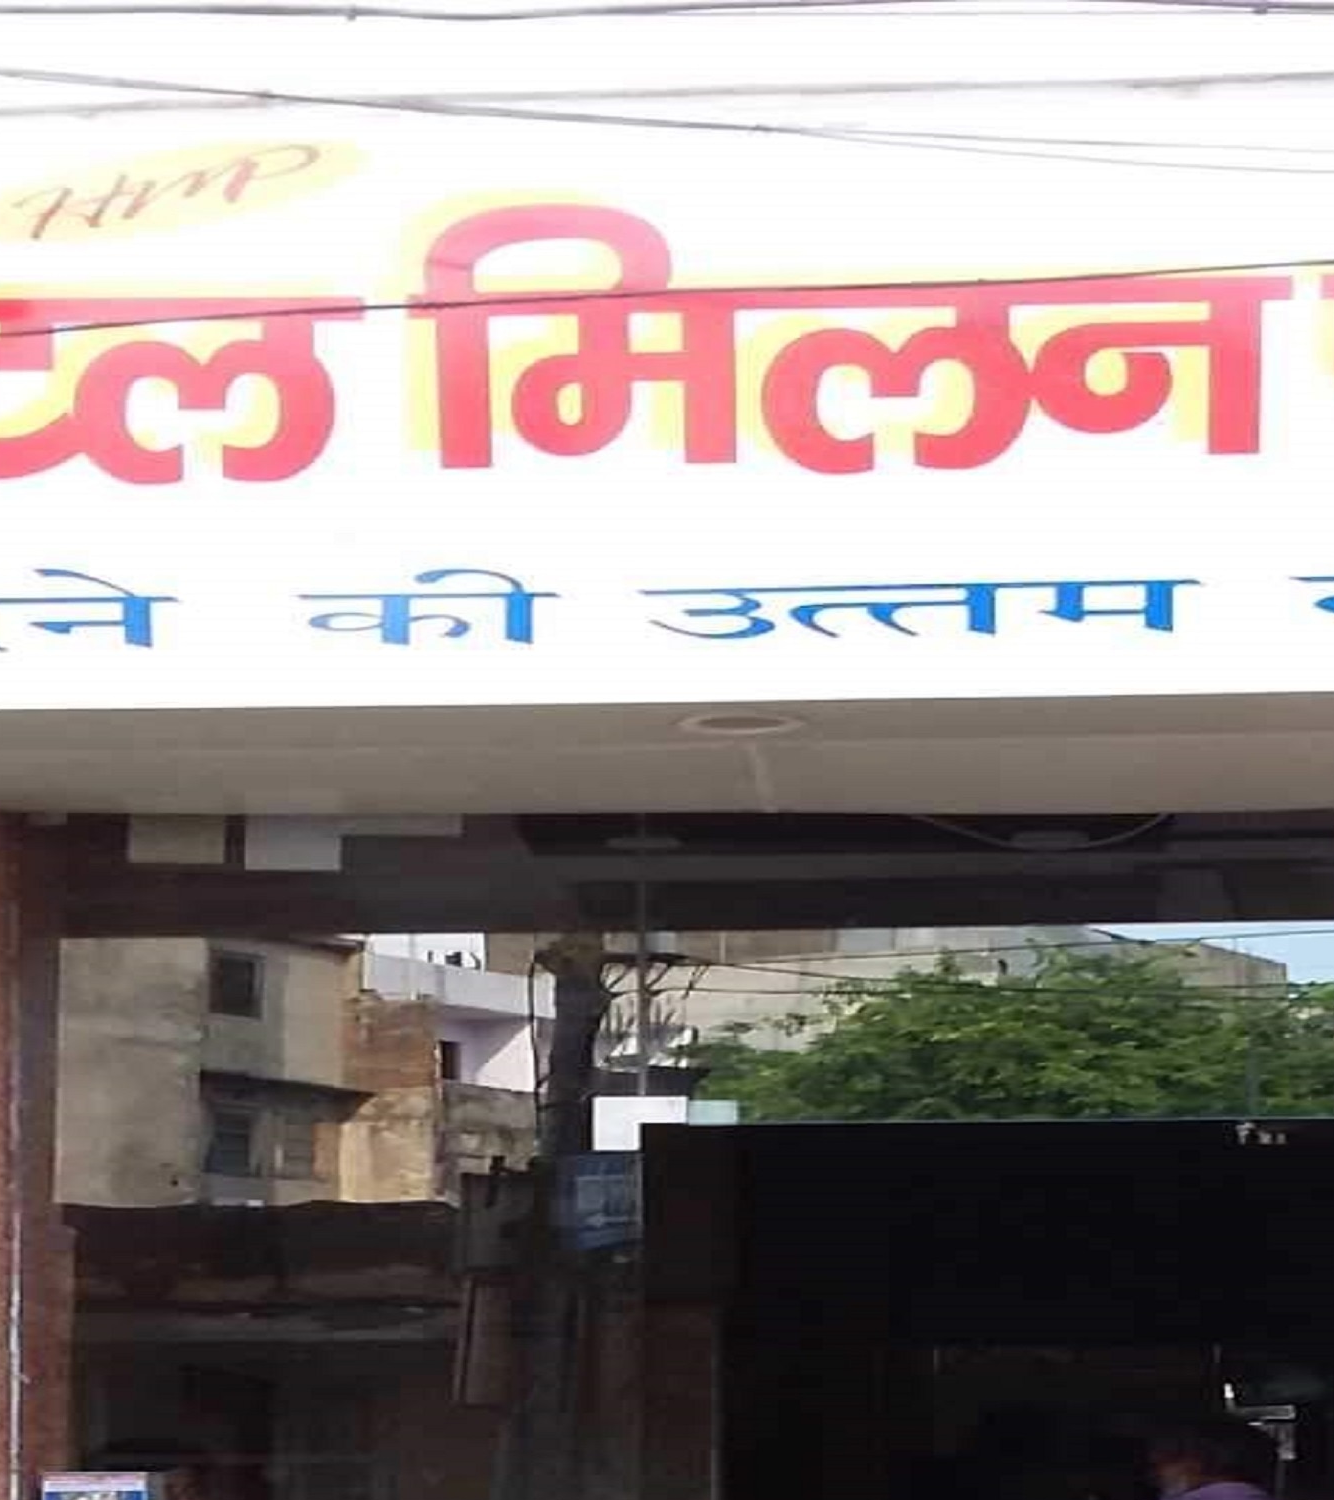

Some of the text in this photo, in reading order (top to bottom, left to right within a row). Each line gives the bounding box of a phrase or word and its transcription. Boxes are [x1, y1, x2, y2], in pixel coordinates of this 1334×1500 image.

[407, 202, 1294, 476] मिलन
[297, 568, 559, 646] की
[637, 578, 1202, 640] उत्तम
